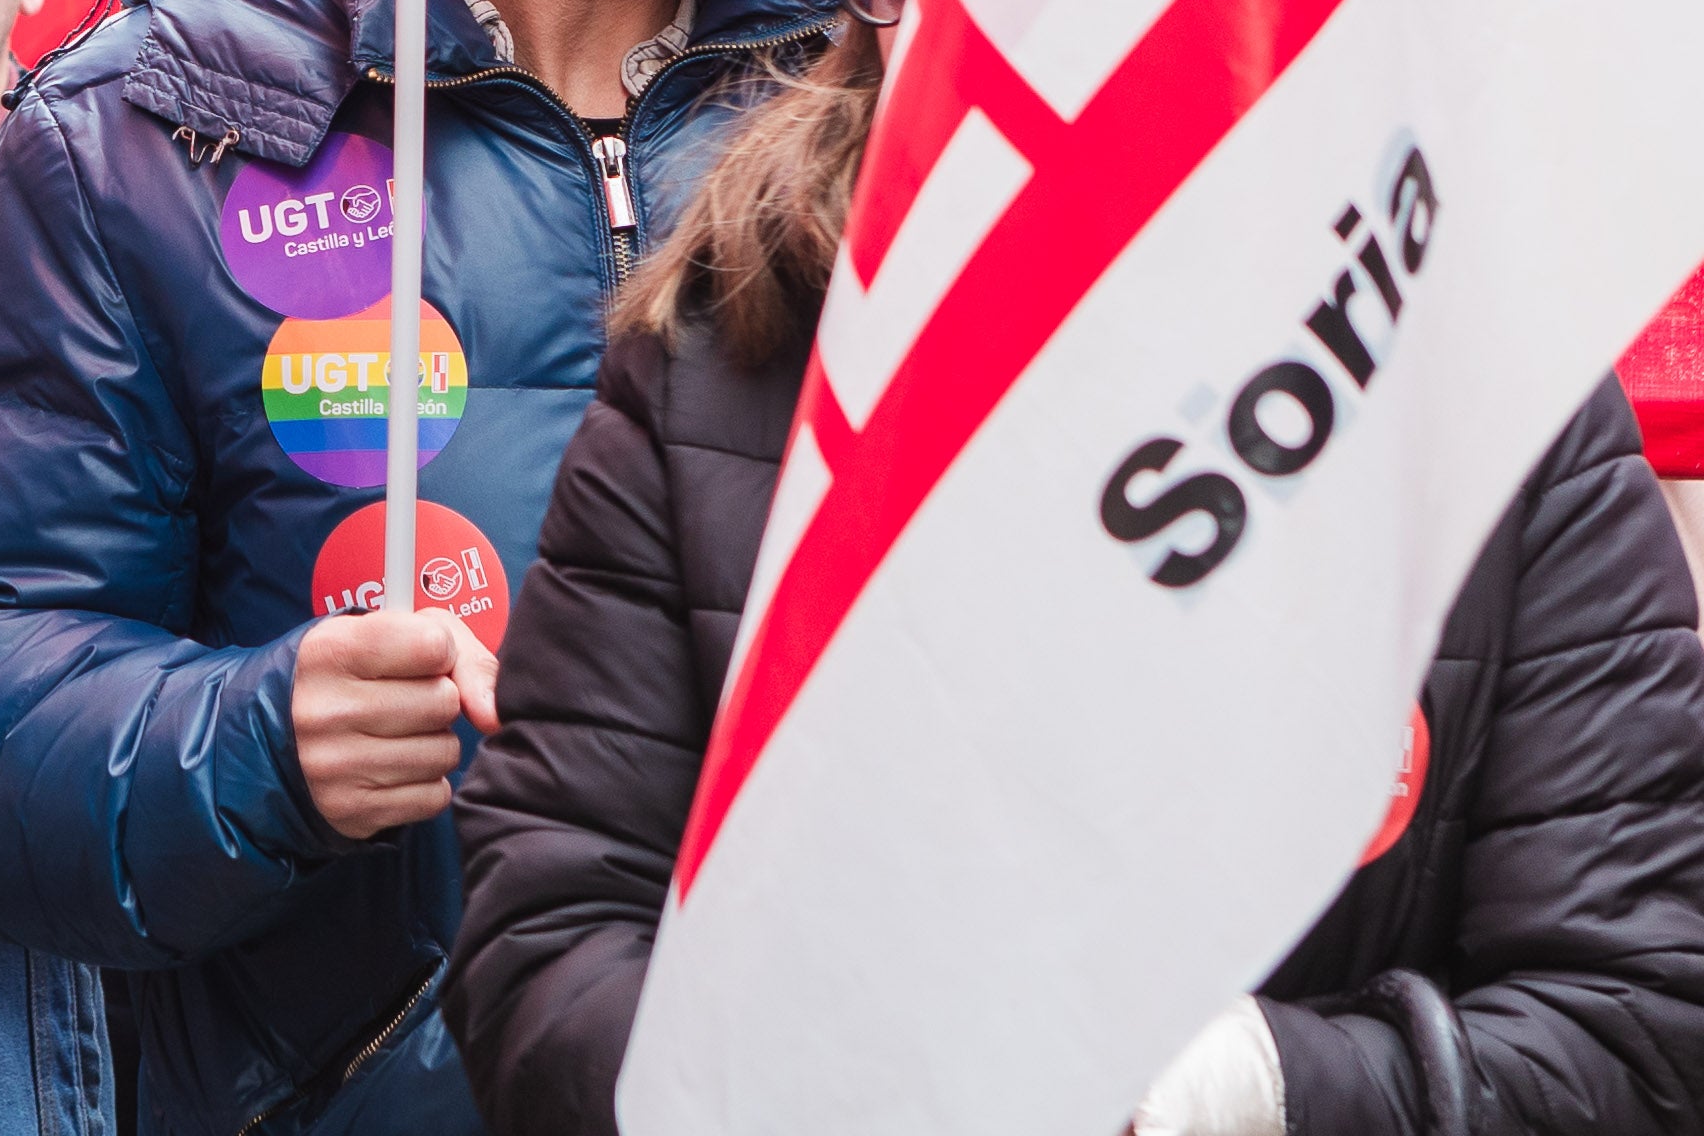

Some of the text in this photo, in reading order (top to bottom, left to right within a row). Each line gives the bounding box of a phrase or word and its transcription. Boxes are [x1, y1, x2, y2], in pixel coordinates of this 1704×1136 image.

[238, 191, 336, 244] UGT
[284, 221, 394, 257] Castilla y Leó
[281, 354, 378, 395] UGT
[1099, 144, 1438, 589] Soria
[319, 398, 447, 415] Castilla eón
[324, 578, 387, 615] UG
